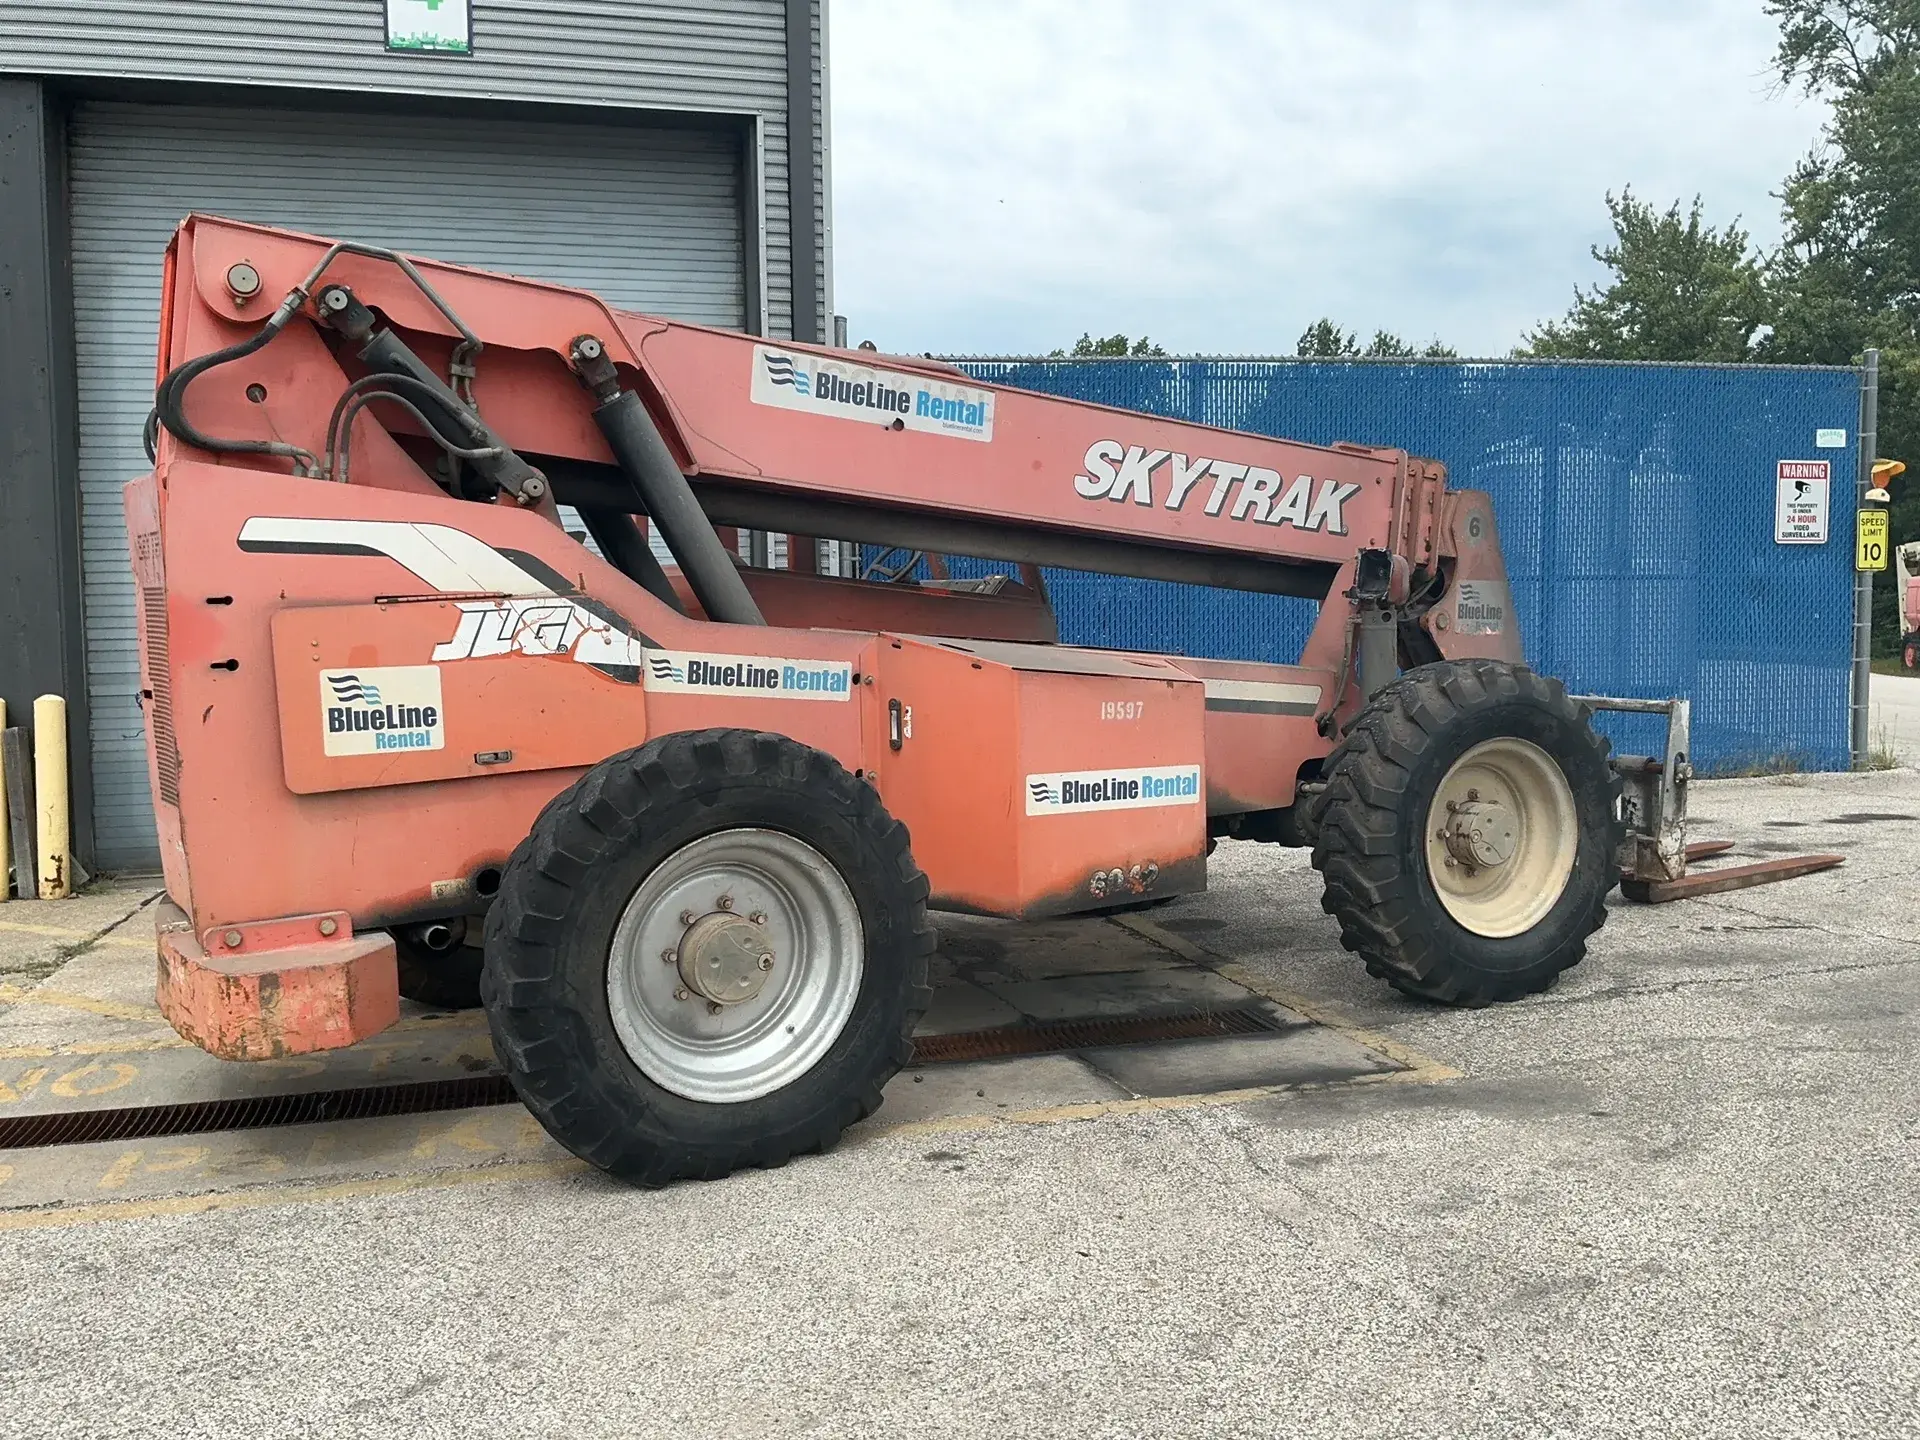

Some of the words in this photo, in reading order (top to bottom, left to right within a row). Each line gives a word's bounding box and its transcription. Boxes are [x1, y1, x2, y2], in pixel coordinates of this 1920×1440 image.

[815, 372, 911, 415] BlueLine
[915, 390, 985, 427] Rental
[1782, 464, 1825, 478] WARNING
[1073, 439, 1362, 537] SKYTRAK
[1469, 516, 1481, 537] 6
[1786, 515, 1796, 523] 24
[1797, 515, 1817, 523] HOUR
[1860, 518, 1885, 526] SPEED
[1863, 528, 1882, 536] LIMIT
[1863, 543, 1882, 561] 10
[1458, 603, 1503, 620] BlueLine
[687, 659, 780, 690] BlueLine
[781, 665, 849, 693] Rental
[328, 704, 438, 733] BlueLine
[1101, 701, 1145, 720] 19597
[375, 729, 432, 750] Rental
[1061, 777, 1139, 805] BlueLine
[1141, 772, 1198, 799] Rental
